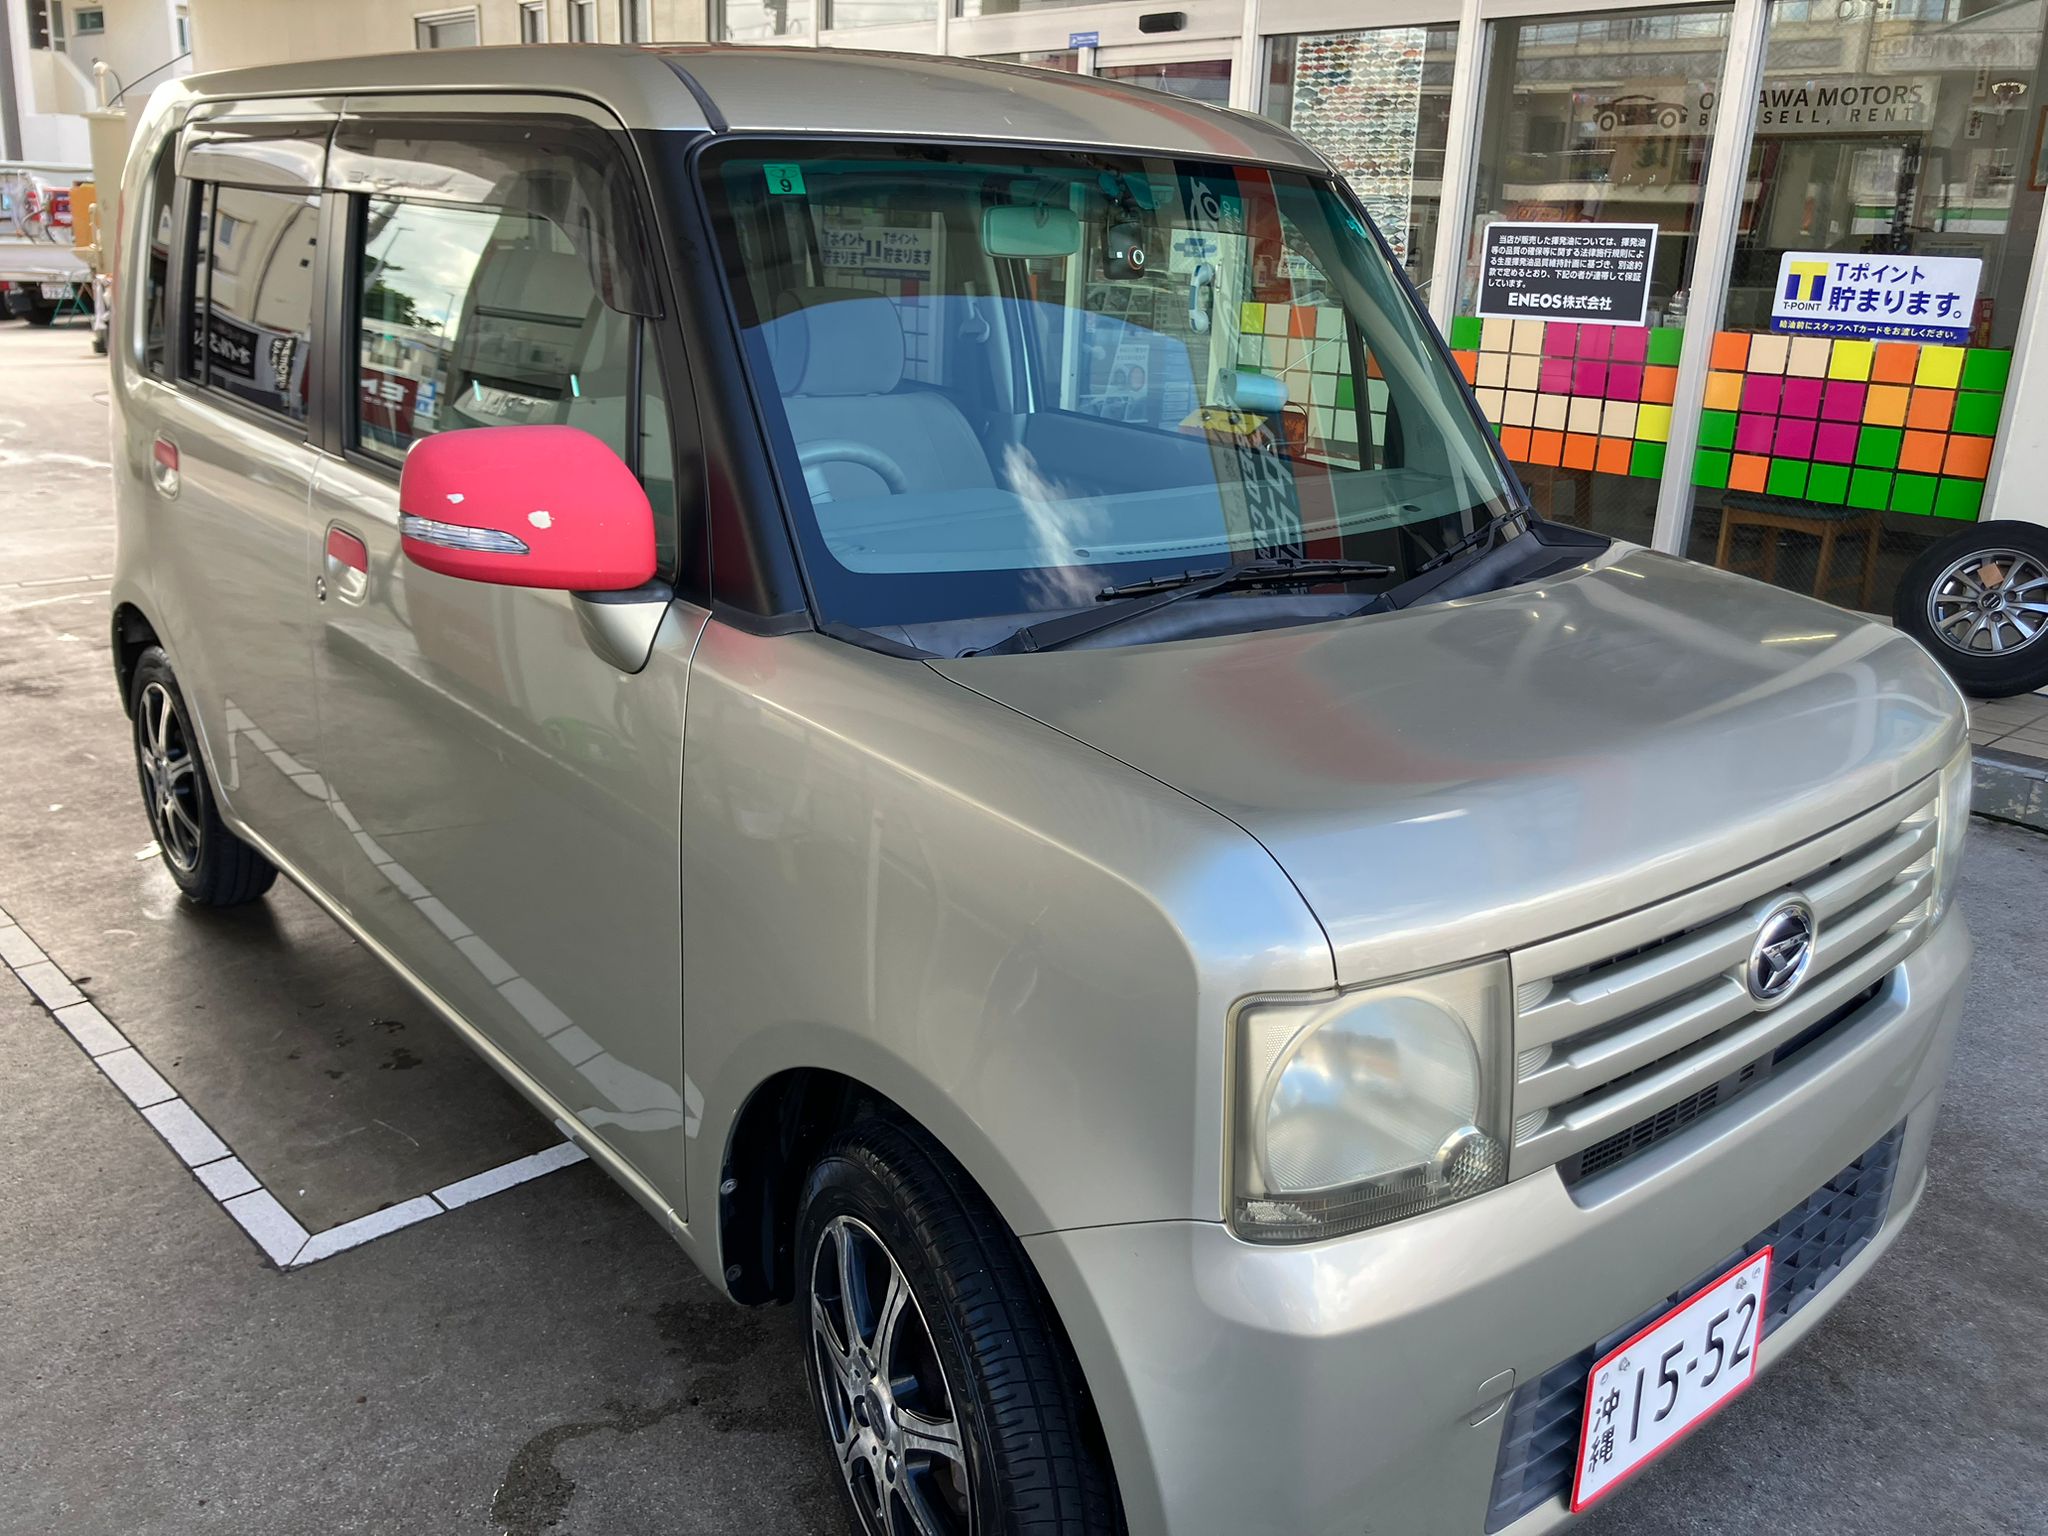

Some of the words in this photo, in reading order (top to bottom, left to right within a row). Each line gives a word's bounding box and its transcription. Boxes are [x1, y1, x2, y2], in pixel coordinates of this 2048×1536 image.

[1699, 89, 1809, 110] OAWA
[1817, 85, 1923, 107] MOTORS
[1763, 109, 1831, 125] SELL,
[1850, 107, 1915, 123] RENT
[780, 179, 792, 192] 9
[1488, 279, 1526, 288] しています。
[1836, 263, 1925, 285] Tポイント
[1784, 302, 1822, 312] T-POINT
[1828, 287, 1961, 319] 貯まります。
[1629, 1293, 1756, 1444] 15-52
[1588, 1386, 1620, 1473] 沖縄
